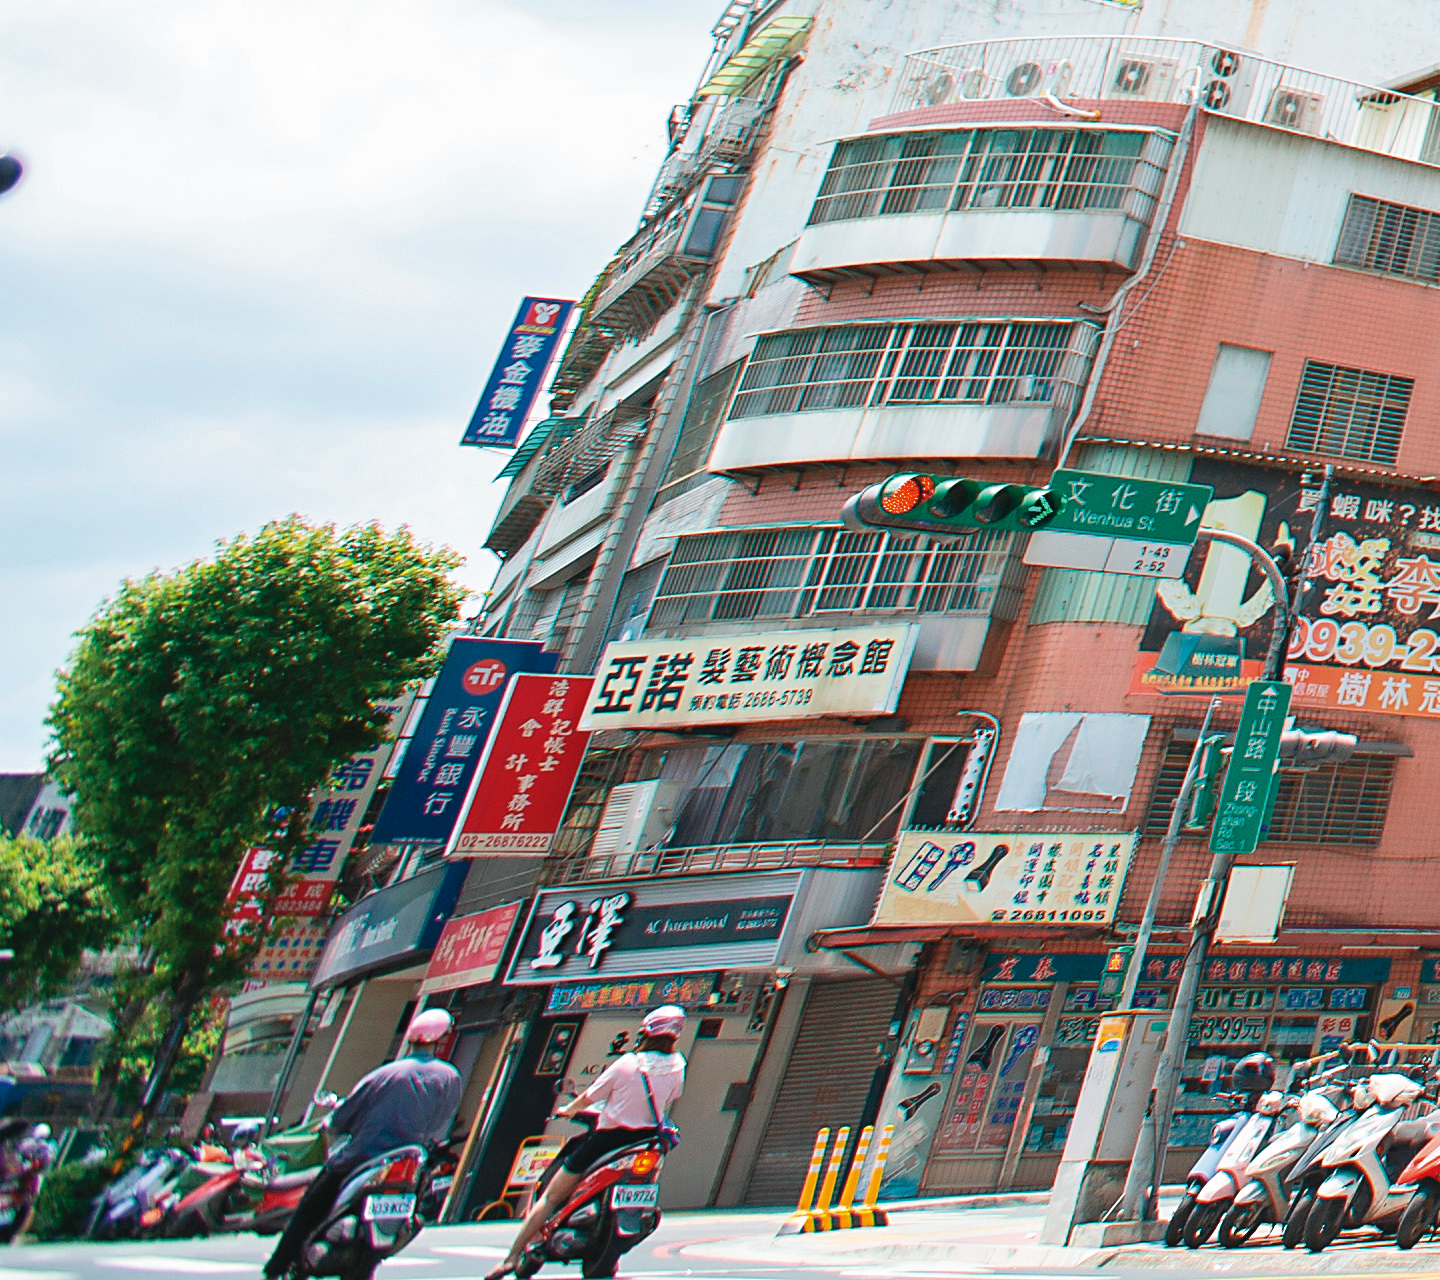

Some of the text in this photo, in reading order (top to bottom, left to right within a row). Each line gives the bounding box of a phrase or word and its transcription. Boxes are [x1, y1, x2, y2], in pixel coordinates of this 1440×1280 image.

[1068, 477, 1184, 516] 文化街
[1073, 508, 1157, 532] Wenhua St.
[1140, 545, 1171, 559] 1-43
[1133, 559, 1166, 572] 2-52
[592, 651, 694, 715] 亞諾
[423, 705, 487, 816] 永豐銀行
[1233, 696, 1278, 803] 中山路一段
[461, 833, 550, 849] 02-26876222
[1009, 909, 1107, 921] 26811095
